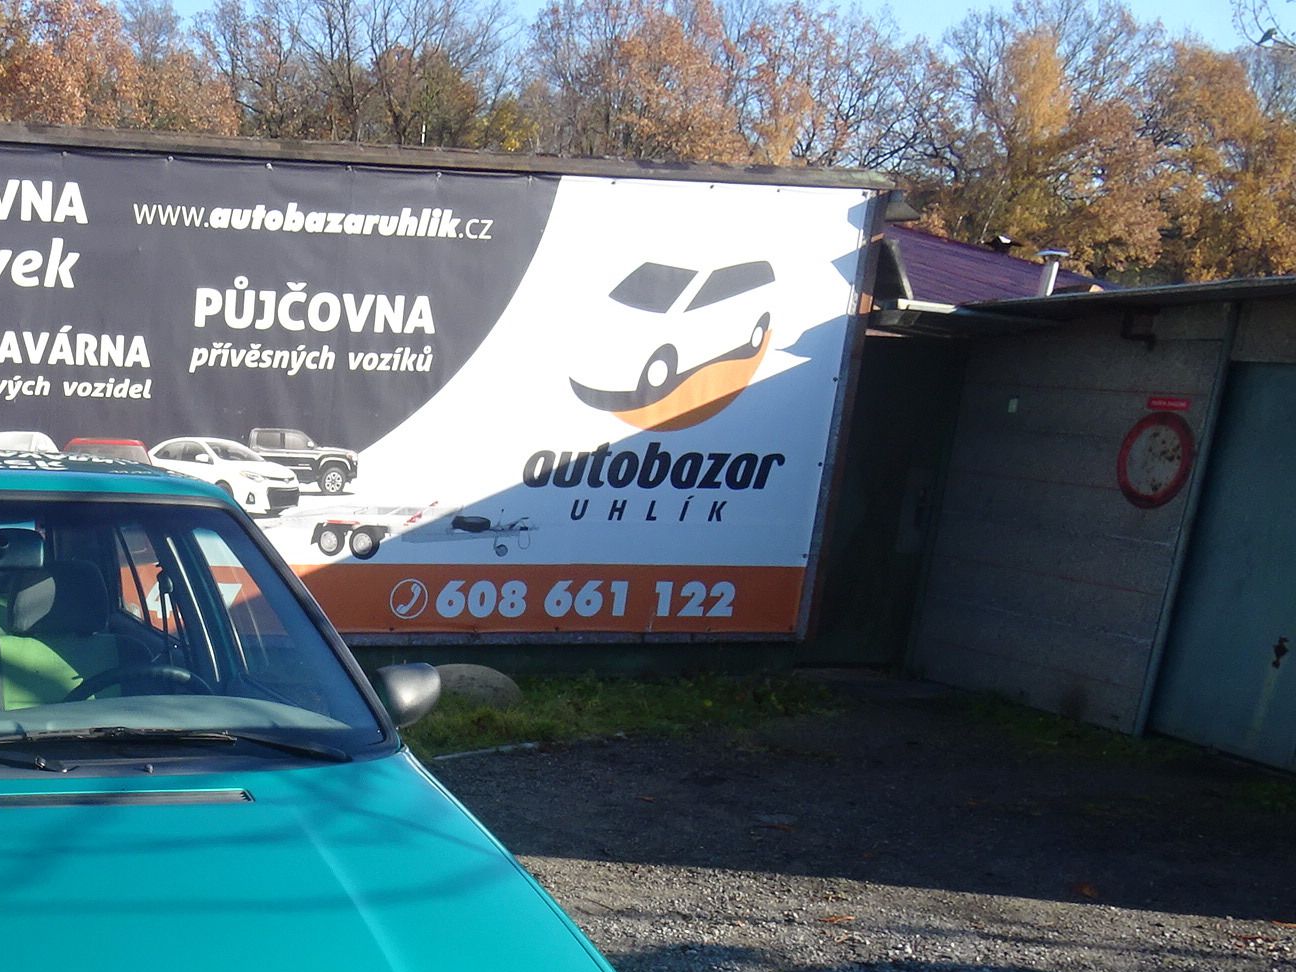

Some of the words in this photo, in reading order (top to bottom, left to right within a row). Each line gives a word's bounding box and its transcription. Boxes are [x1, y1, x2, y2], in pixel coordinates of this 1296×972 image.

[133, 202, 494, 240] www.autobazaruhlik.cz
[194, 275, 436, 334] PŮJČOVNA
[188, 342, 336, 376] přívěsných
[348, 345, 434, 372] vozíků
[63, 378, 152, 400] vozidel
[522, 442, 786, 491] autobazar
[570, 495, 730, 523] UHLÍK
[435, 579, 528, 618] 608
[544, 579, 629, 617] 661
[654, 580, 737, 617] 122
